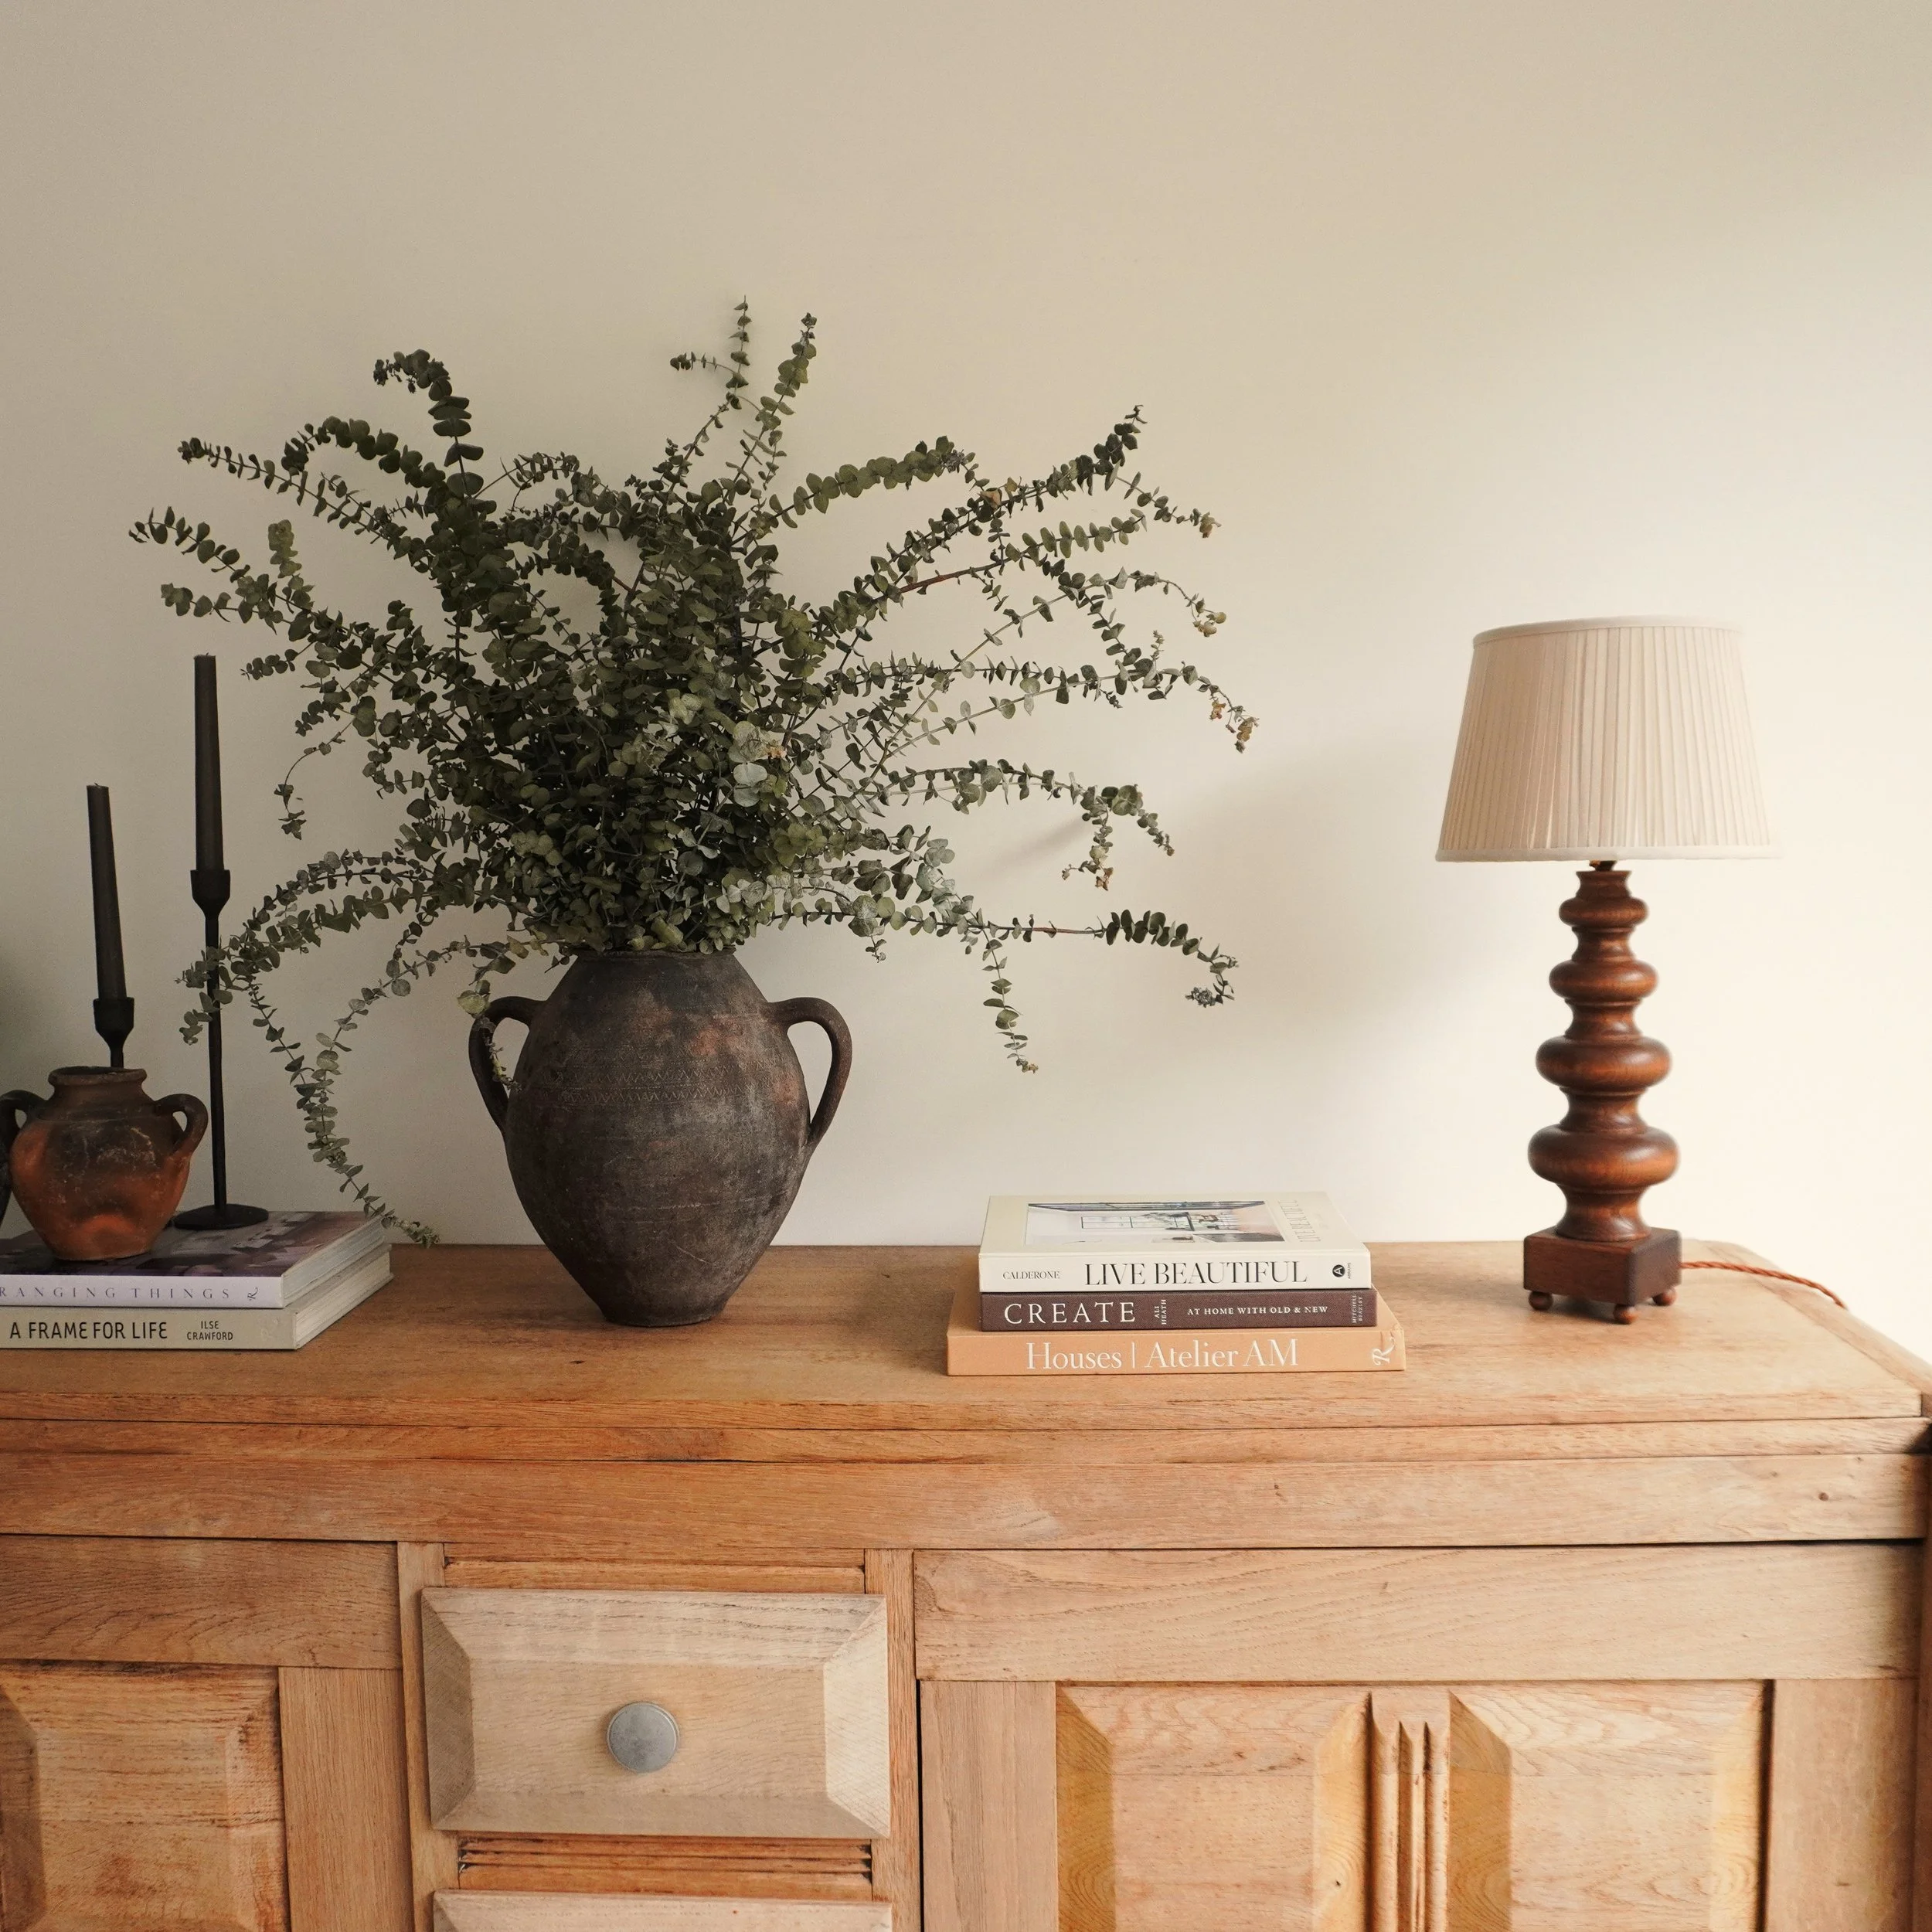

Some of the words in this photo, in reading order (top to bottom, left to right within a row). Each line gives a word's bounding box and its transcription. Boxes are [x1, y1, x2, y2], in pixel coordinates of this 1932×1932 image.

[1002, 1270, 1060, 1280] CALDERONE
[1084, 1263, 1146, 1285] LIVE
[1154, 1260, 1308, 1284] BEAUTIFUL
[0, 1286, 115, 1298] RANGING
[131, 1287, 230, 1299] THINGS
[1004, 1301, 1136, 1325] CREATE
[10, 1321, 21, 1339] A
[29, 1321, 87, 1339] FRAME
[94, 1321, 126, 1339] FOR
[132, 1321, 168, 1339] LIFE
[200, 1321, 219, 1329] ILSE
[186, 1332, 233, 1341] CRAWFORD
[1026, 1342, 1122, 1370] Houses
[1144, 1339, 1239, 1369] Atelier
[1242, 1338, 1298, 1367] AM
